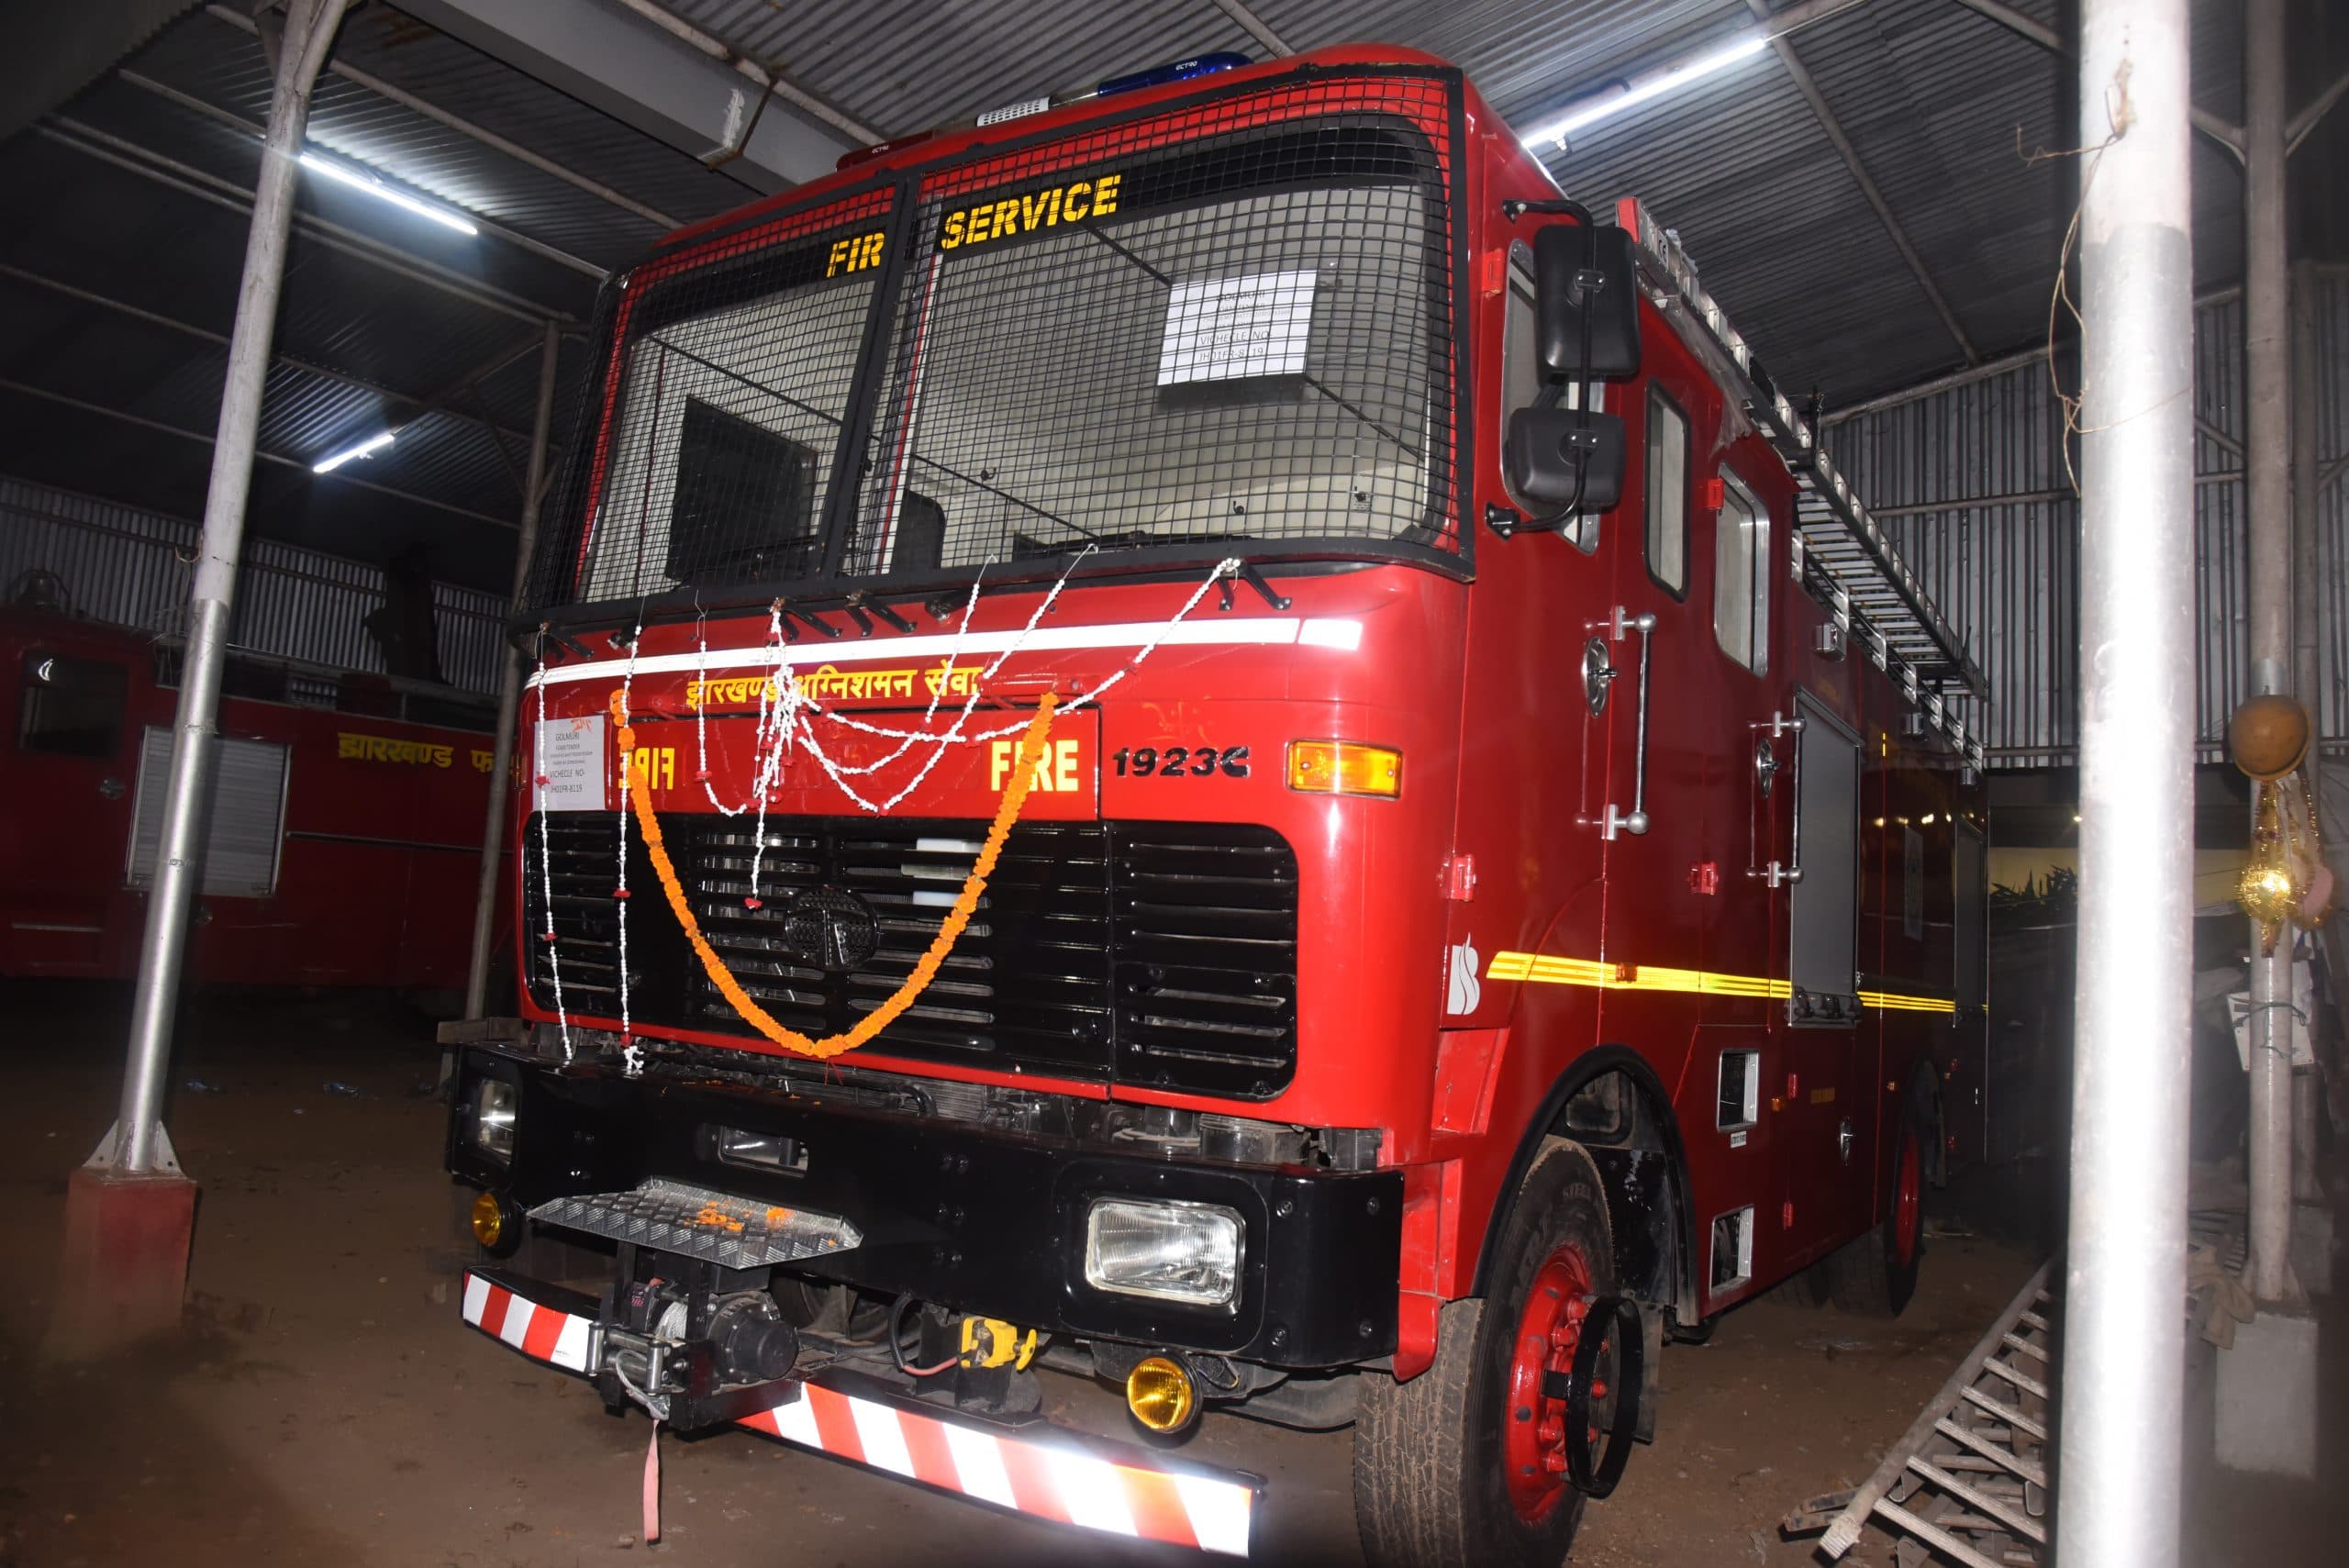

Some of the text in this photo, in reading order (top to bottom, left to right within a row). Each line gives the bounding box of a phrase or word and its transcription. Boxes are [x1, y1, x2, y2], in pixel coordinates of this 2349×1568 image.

[827, 174, 1121, 278] FIR SERVICE
[1199, 347, 1264, 361] JH01FR-819
